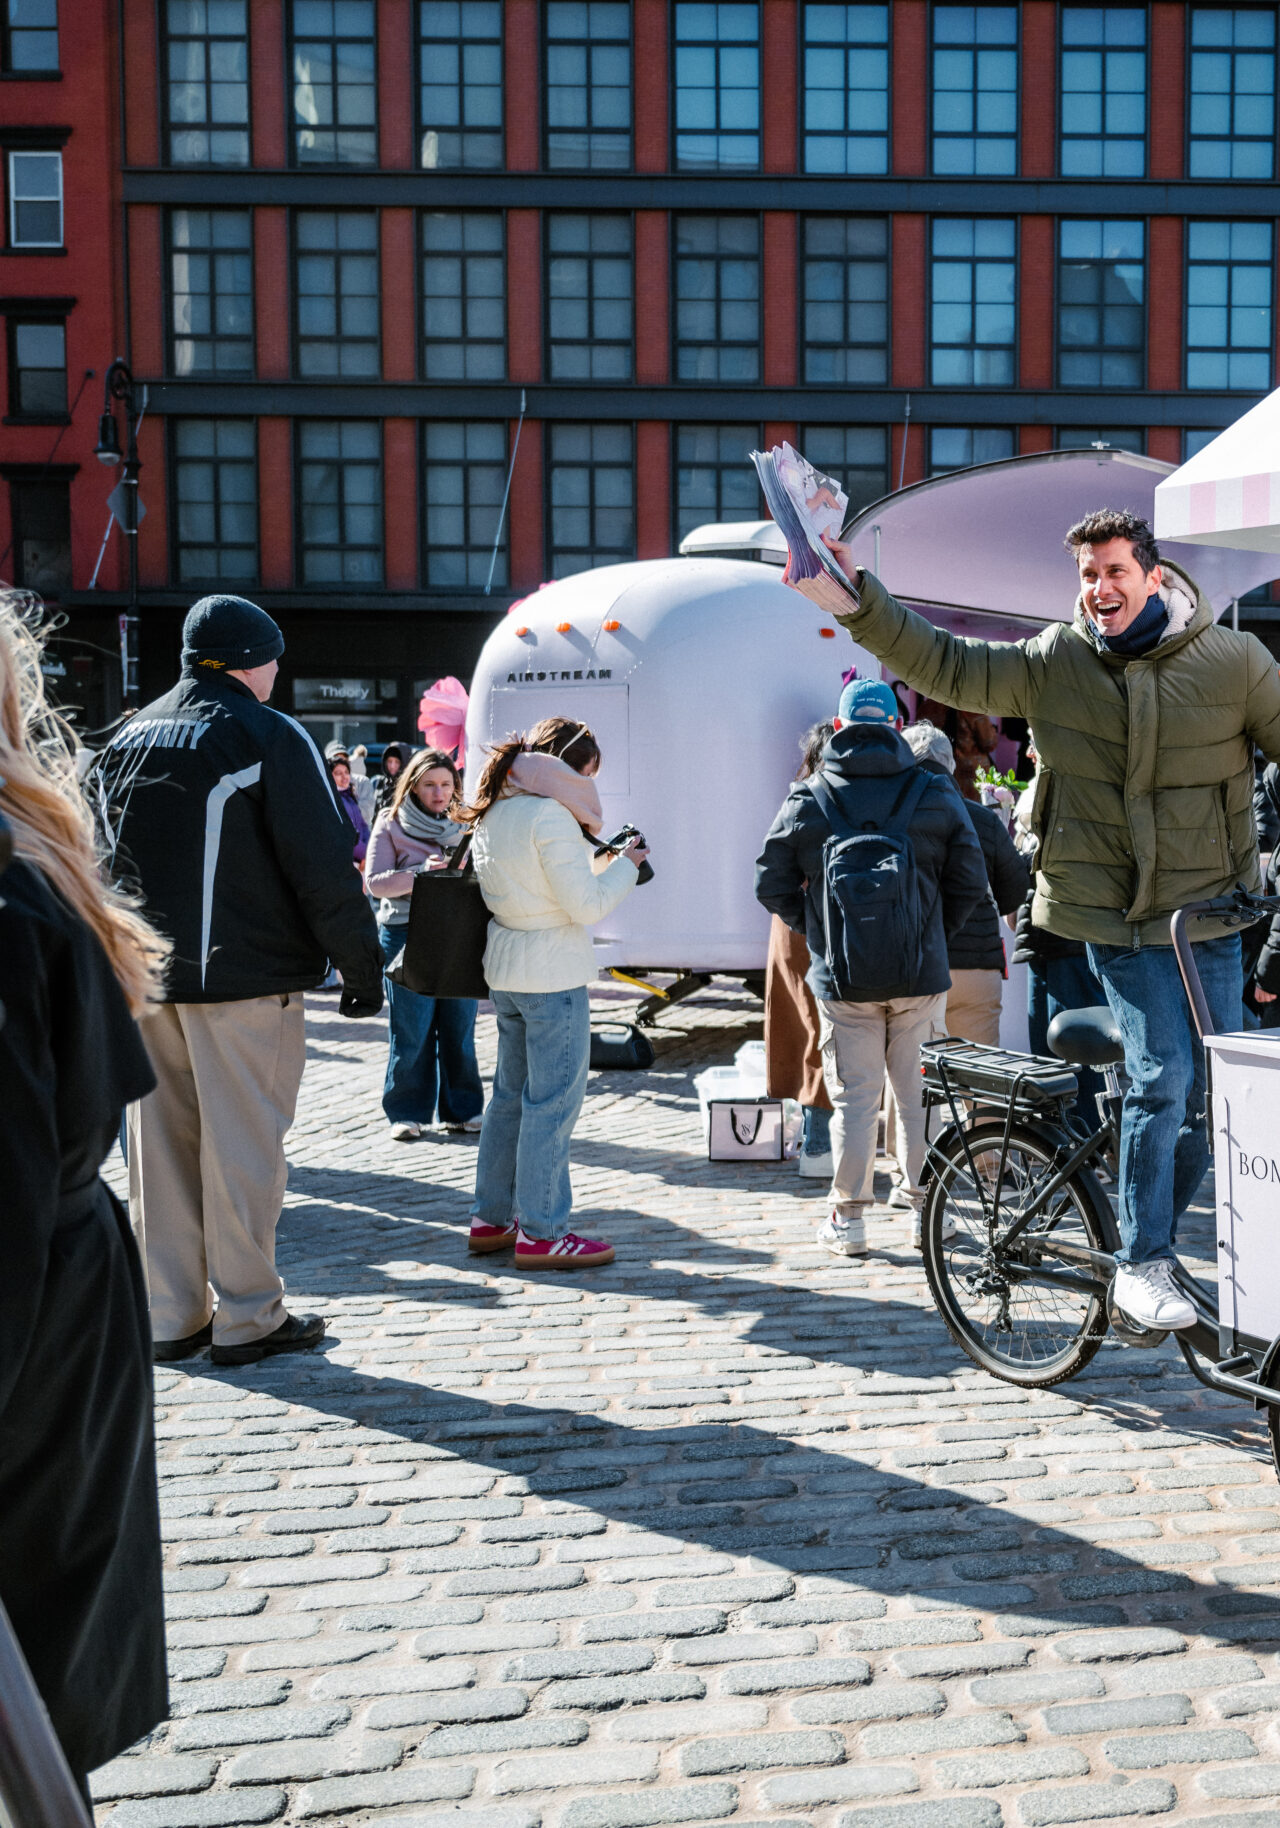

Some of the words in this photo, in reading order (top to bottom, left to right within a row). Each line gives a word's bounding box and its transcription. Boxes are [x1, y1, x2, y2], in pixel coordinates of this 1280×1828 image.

[507, 669, 613, 683] AIRSTREAM
[320, 685, 369, 700] Theory
[113, 720, 212, 750] SECURITY
